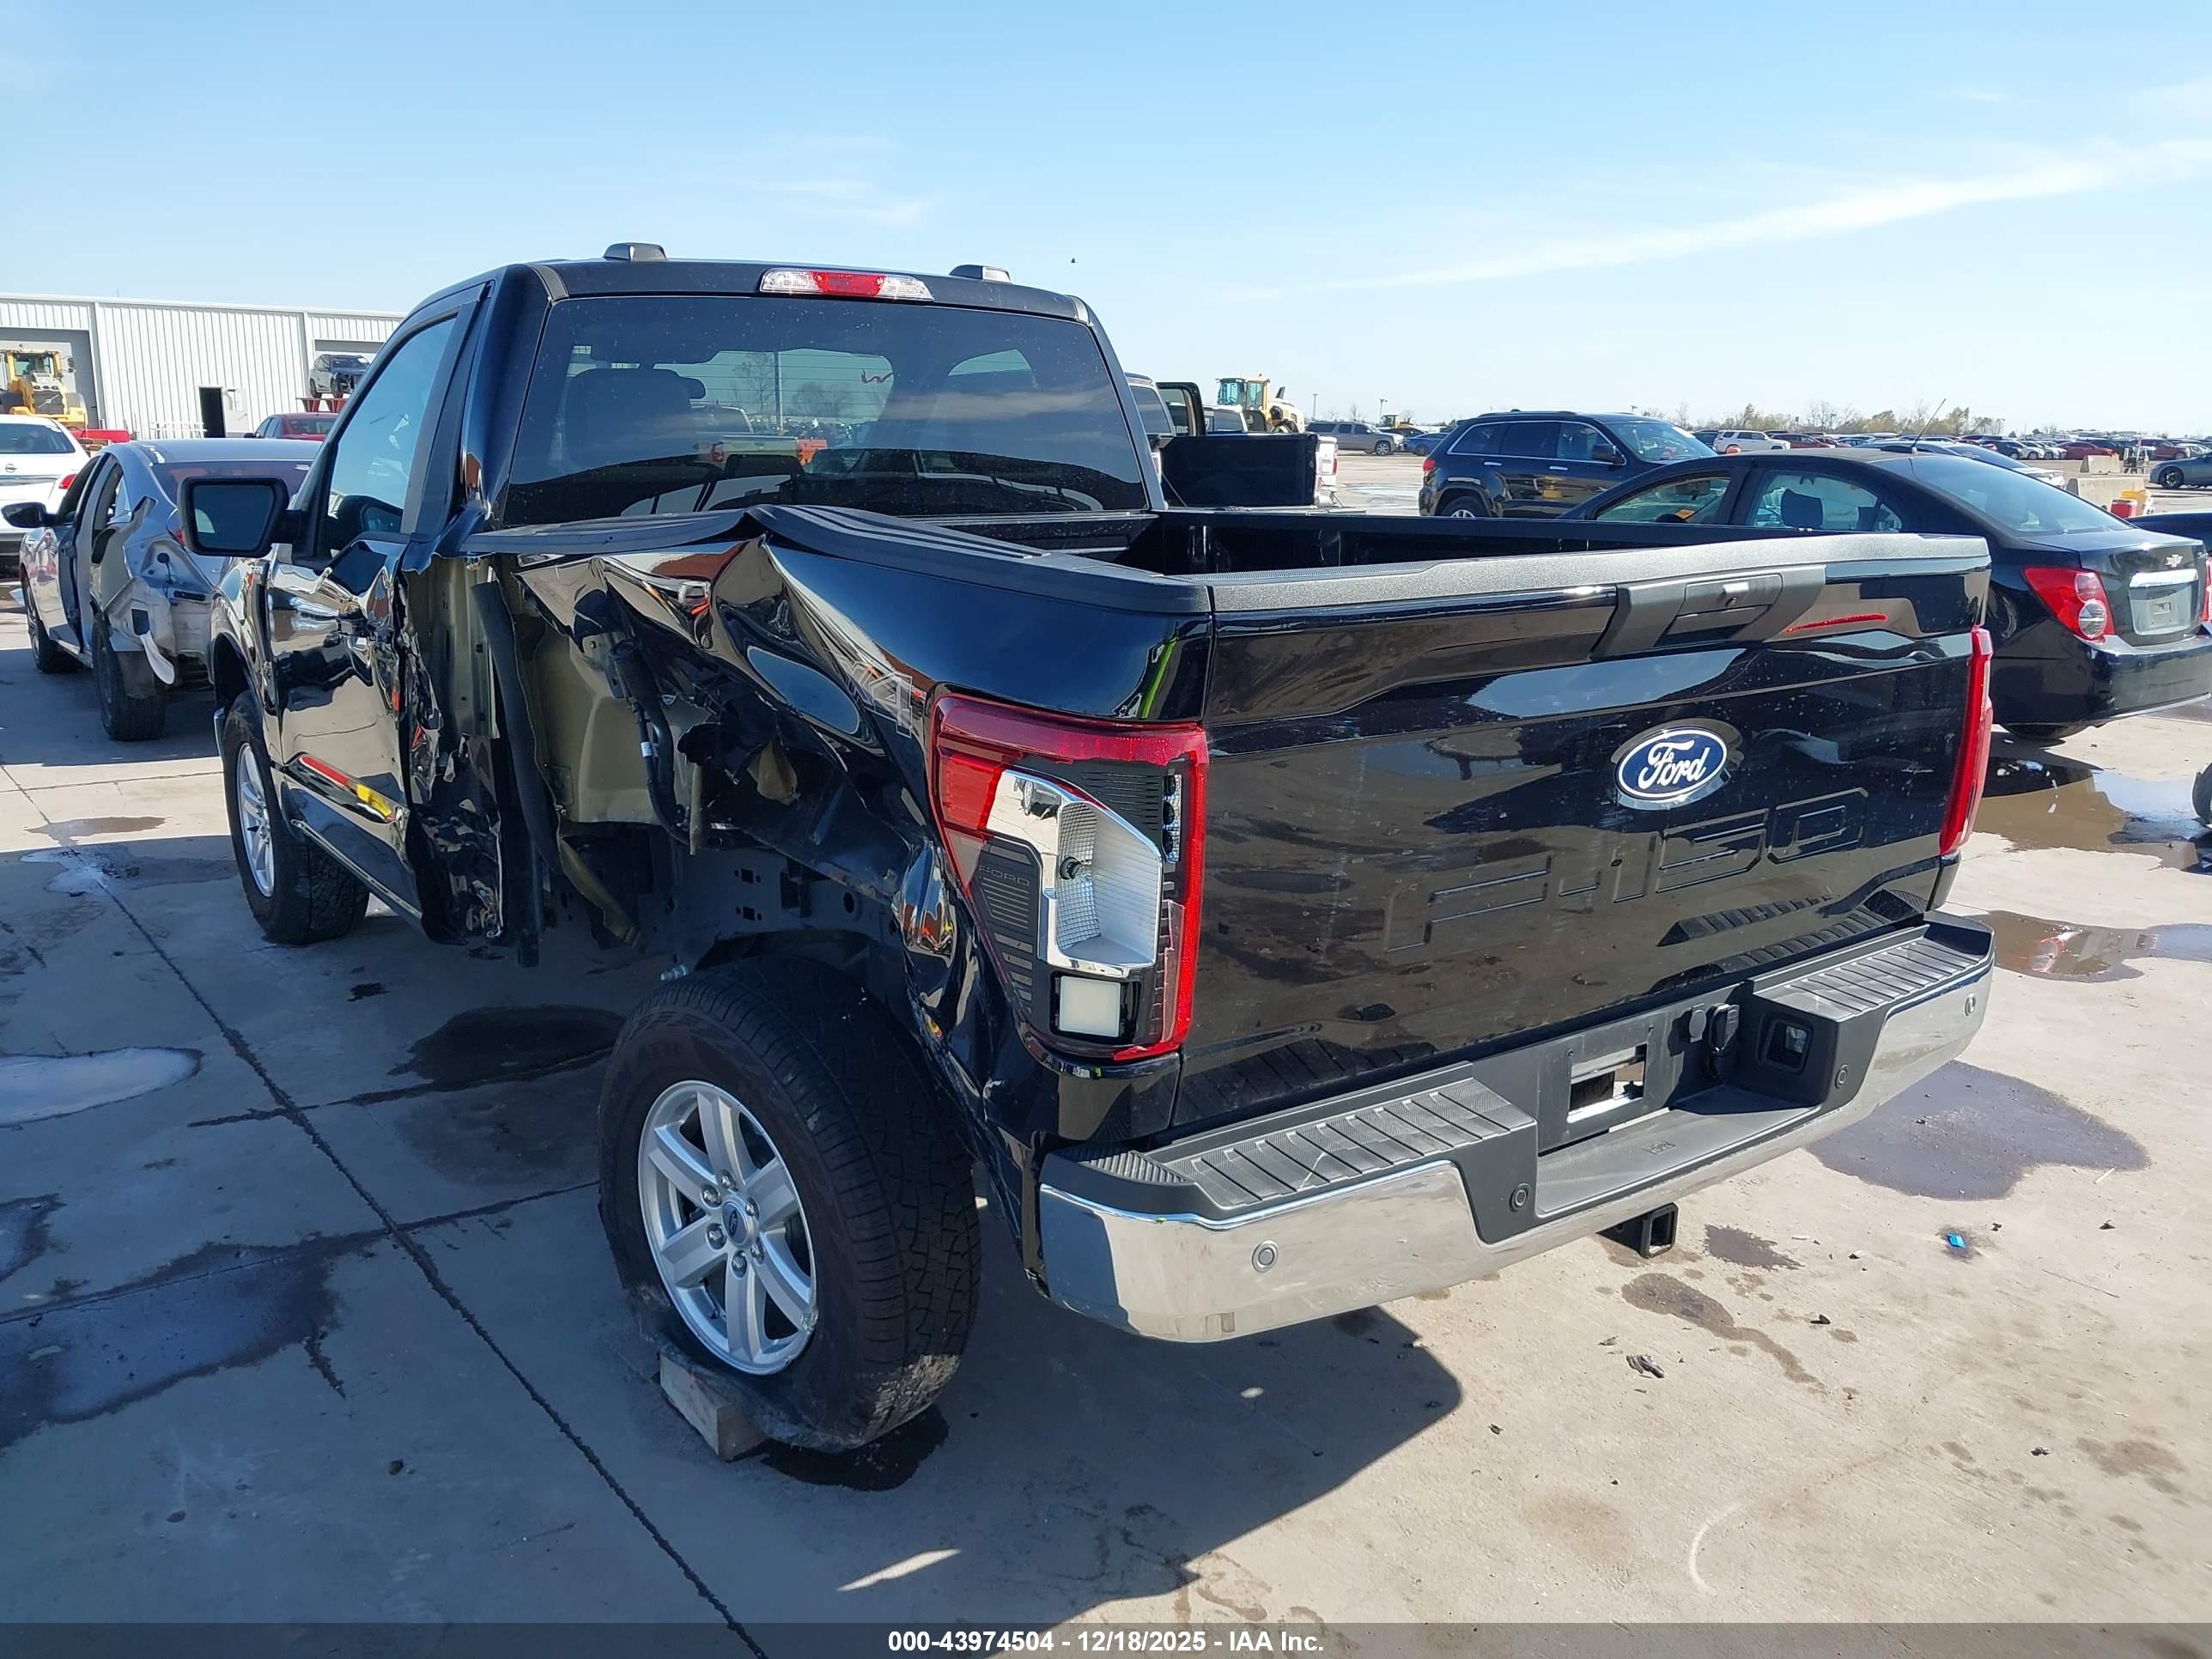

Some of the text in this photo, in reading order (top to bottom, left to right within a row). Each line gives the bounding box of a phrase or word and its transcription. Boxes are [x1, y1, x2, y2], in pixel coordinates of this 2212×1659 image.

[1637, 738, 1711, 790] Ford
[979, 865, 1030, 887] FORD
[1383, 786, 1869, 954] F-150
